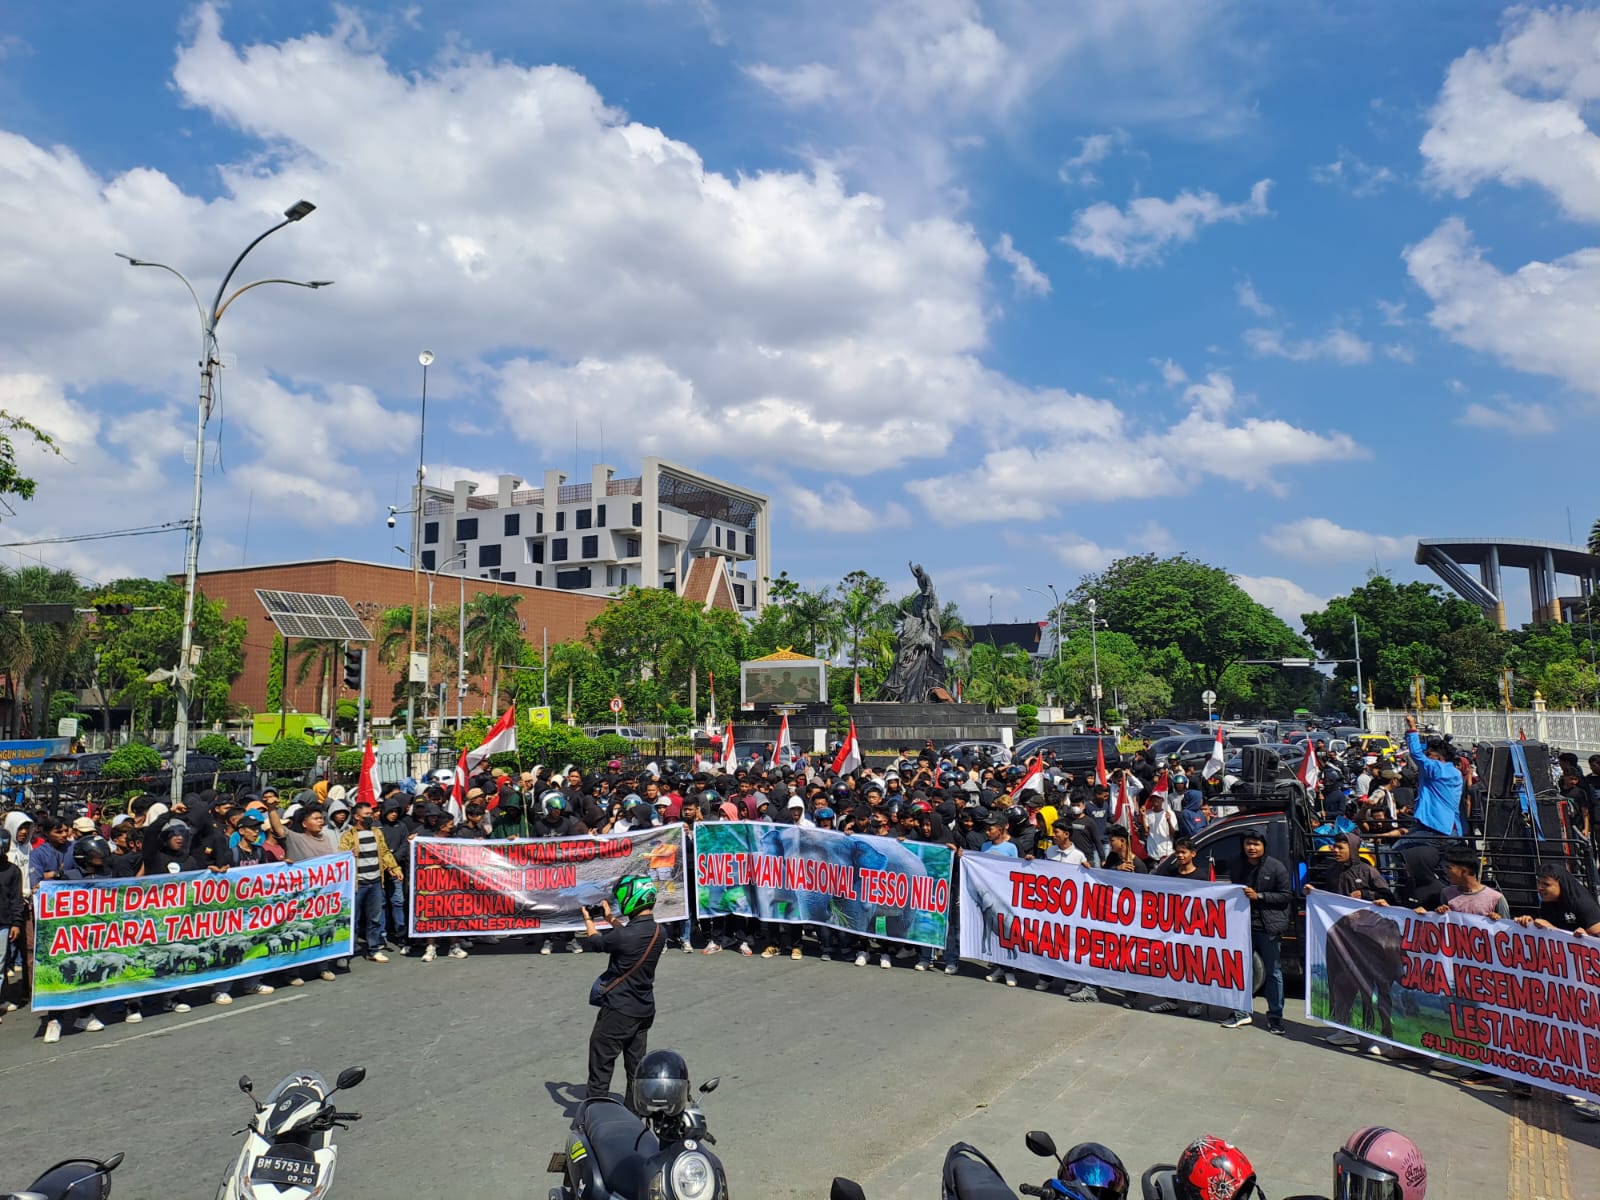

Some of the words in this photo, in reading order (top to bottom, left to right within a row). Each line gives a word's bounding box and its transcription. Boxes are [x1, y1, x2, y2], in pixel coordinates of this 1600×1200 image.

[416, 842, 504, 866] LESTARIKAN
[508, 842, 557, 866] HUTAN
[560, 841, 596, 862] TESO
[598, 837, 633, 860] NILO
[416, 868, 471, 892] RUMAH
[473, 866, 523, 892] GAJAH
[525, 865, 577, 891] BUKAN
[39, 887, 116, 919] LEBIH
[124, 881, 187, 912] DARI
[193, 880, 230, 905] 100
[235, 868, 304, 903] GAJAH
[307, 860, 350, 890] MATI
[415, 894, 515, 918] PERKEBUNAN
[697, 853, 735, 887] SAVE
[736, 853, 784, 889] TAMAN
[785, 857, 857, 901] NASIONAL
[859, 867, 909, 908] TESSO
[911, 875, 949, 915] NILO
[1009, 871, 1078, 916] TESSO
[1081, 882, 1136, 927] NILO
[1140, 890, 1227, 939] BUKAN
[49, 918, 158, 956] ANTARA
[164, 909, 243, 943] TAHUN
[248, 891, 342, 930] 2006-2013
[415, 917, 541, 933] #HUTANLESTARI
[997, 913, 1070, 962] LAHAN
[1074, 926, 1245, 992] PERKEBUNAN
[1401, 917, 1493, 964] LINDUNGI
[1494, 931, 1568, 979] GAJAH
[1400, 955, 1452, 997] JAGA
[1453, 963, 1600, 1031] KESEIMBANGA
[1449, 1002, 1582, 1069] LESTARIKAN
[1583, 1033, 1600, 1075] B
[257, 1158, 272, 1169] BM
[274, 1159, 300, 1173] 5753
[303, 1163, 316, 1175] LL
